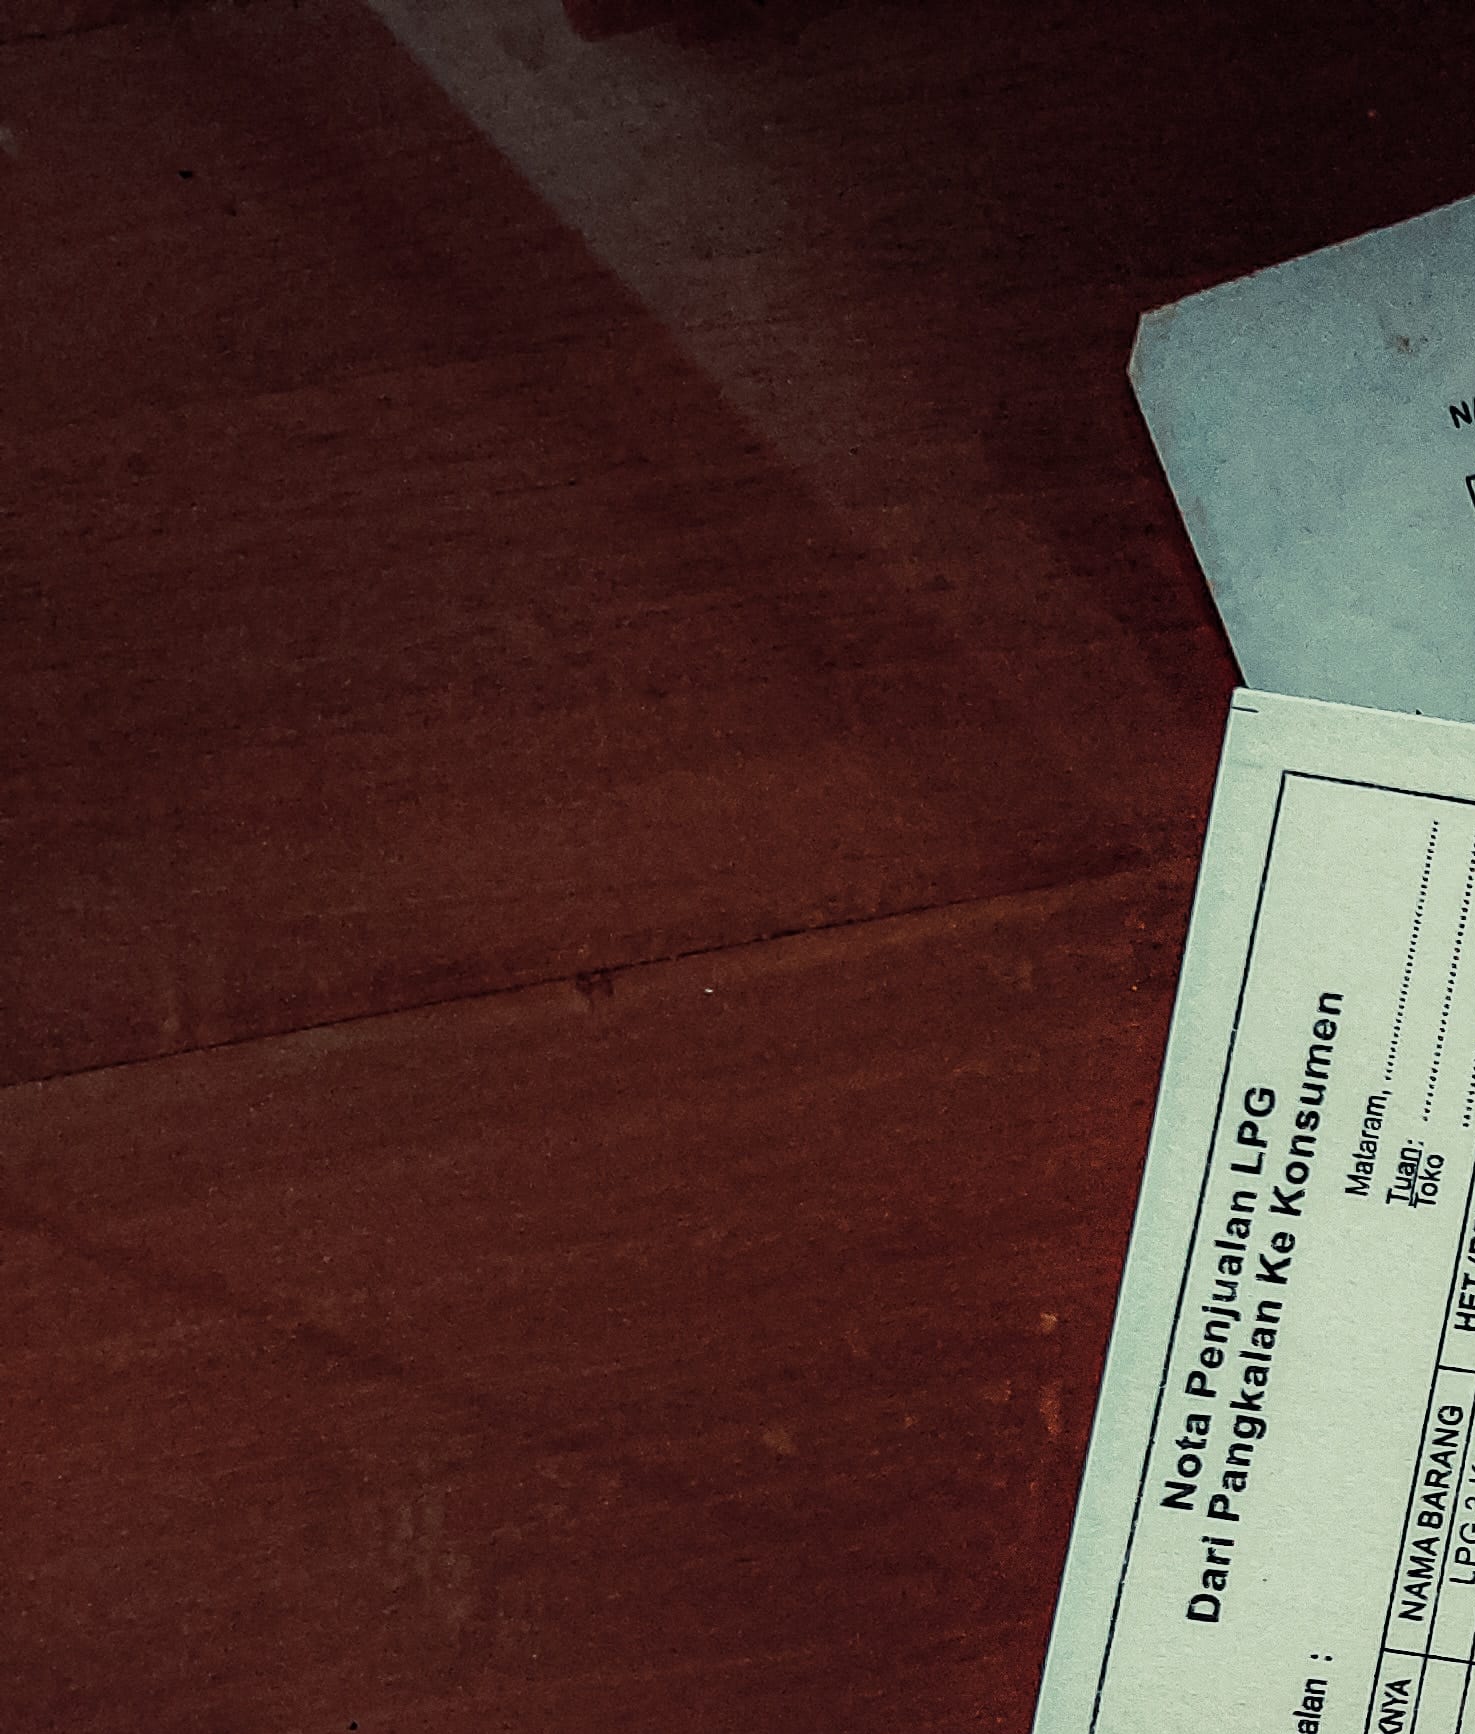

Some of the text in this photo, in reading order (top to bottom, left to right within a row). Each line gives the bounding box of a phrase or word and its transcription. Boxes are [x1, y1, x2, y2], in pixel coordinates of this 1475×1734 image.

[1345, 1091, 1391, 1196] Mataram,
[1412, 1155, 1444, 1208] Toko
[1161, 1088, 1275, 1510] Nota Penjualan LPG
[1186, 993, 1342, 1622] Dari Pangkalan Ke Konsumen
[1418, 1406, 1463, 1529] BARANG
[1398, 1538, 1440, 1621] NAMA
